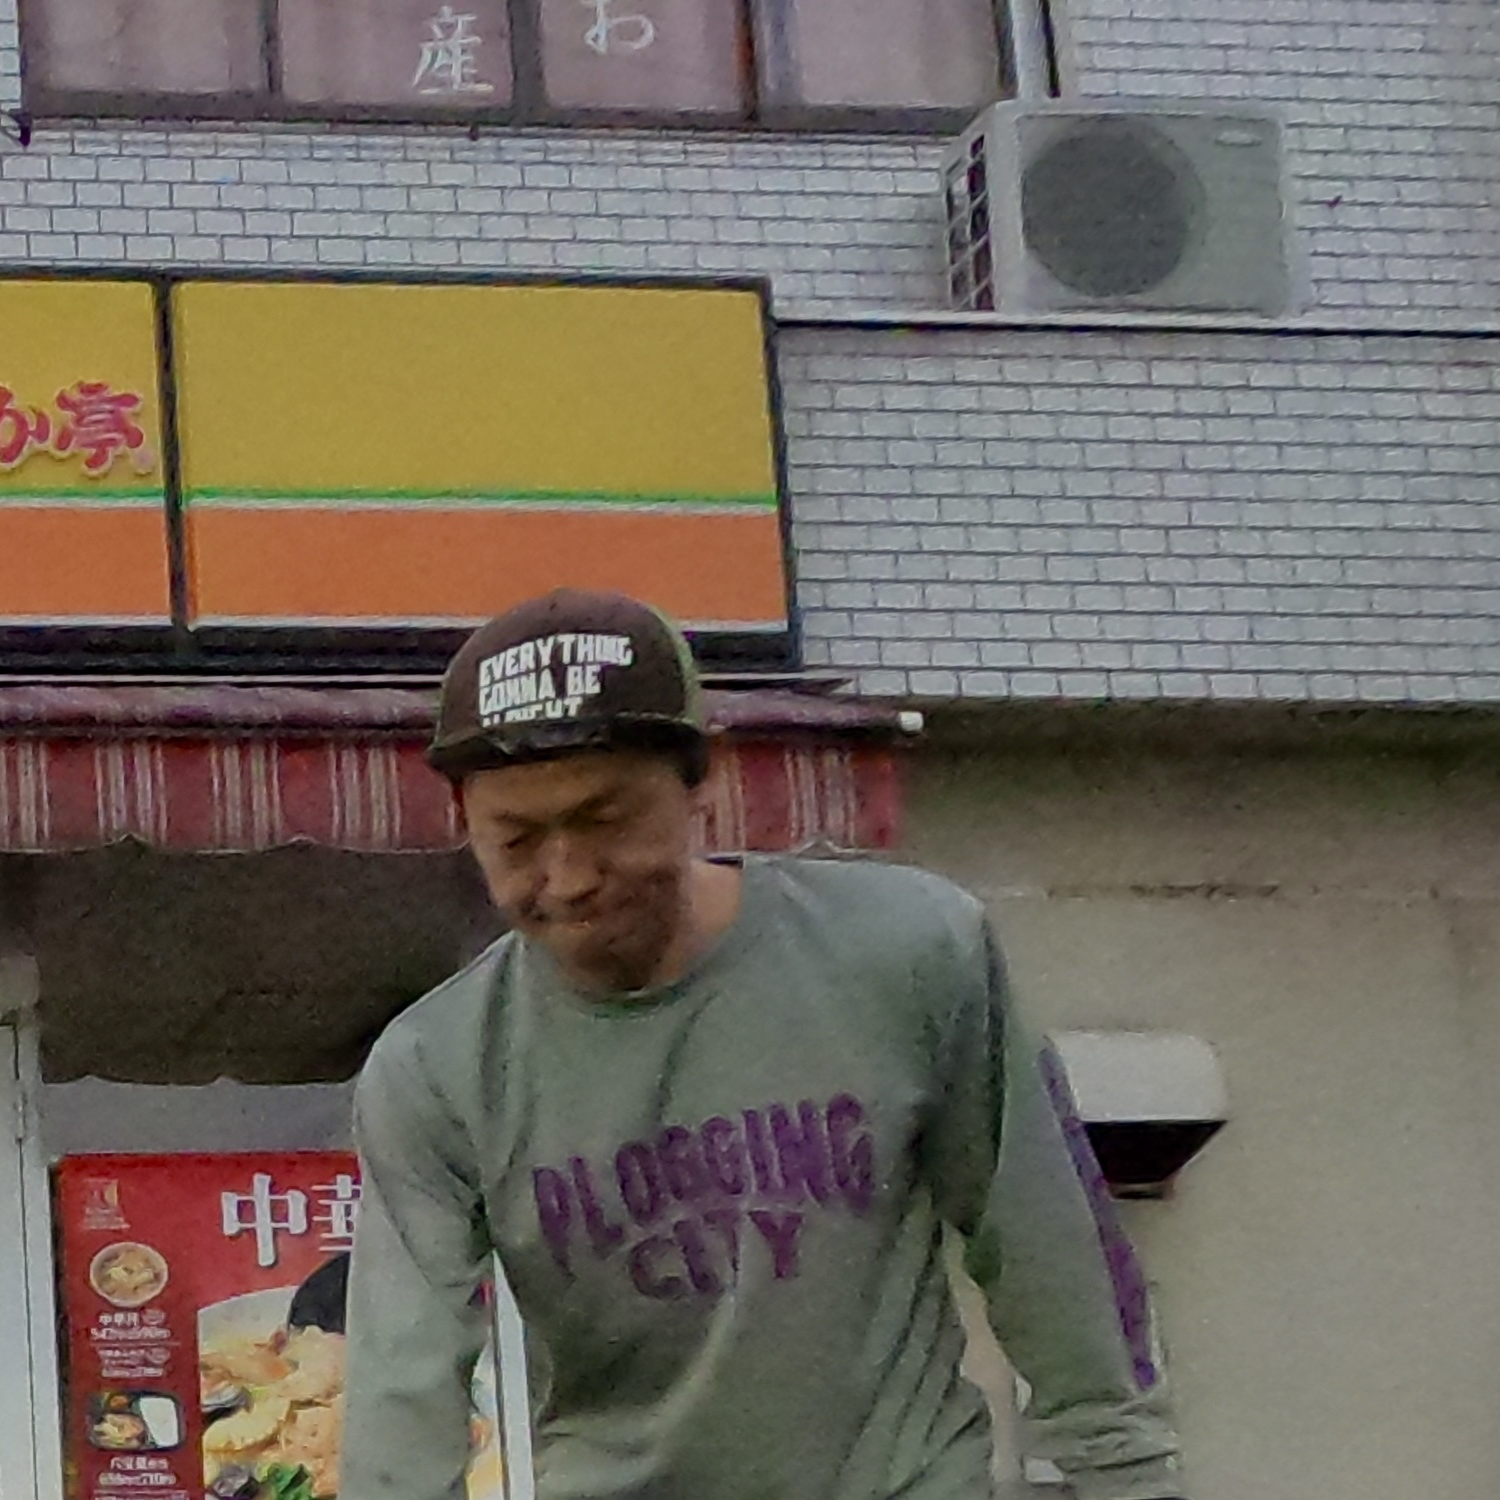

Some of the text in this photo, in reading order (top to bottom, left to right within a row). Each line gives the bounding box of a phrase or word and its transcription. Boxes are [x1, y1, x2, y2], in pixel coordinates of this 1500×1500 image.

[479, 632, 633, 686] EVERYTHING
[566, 664, 601, 696] BE
[630, 1207, 805, 1300] CITY
